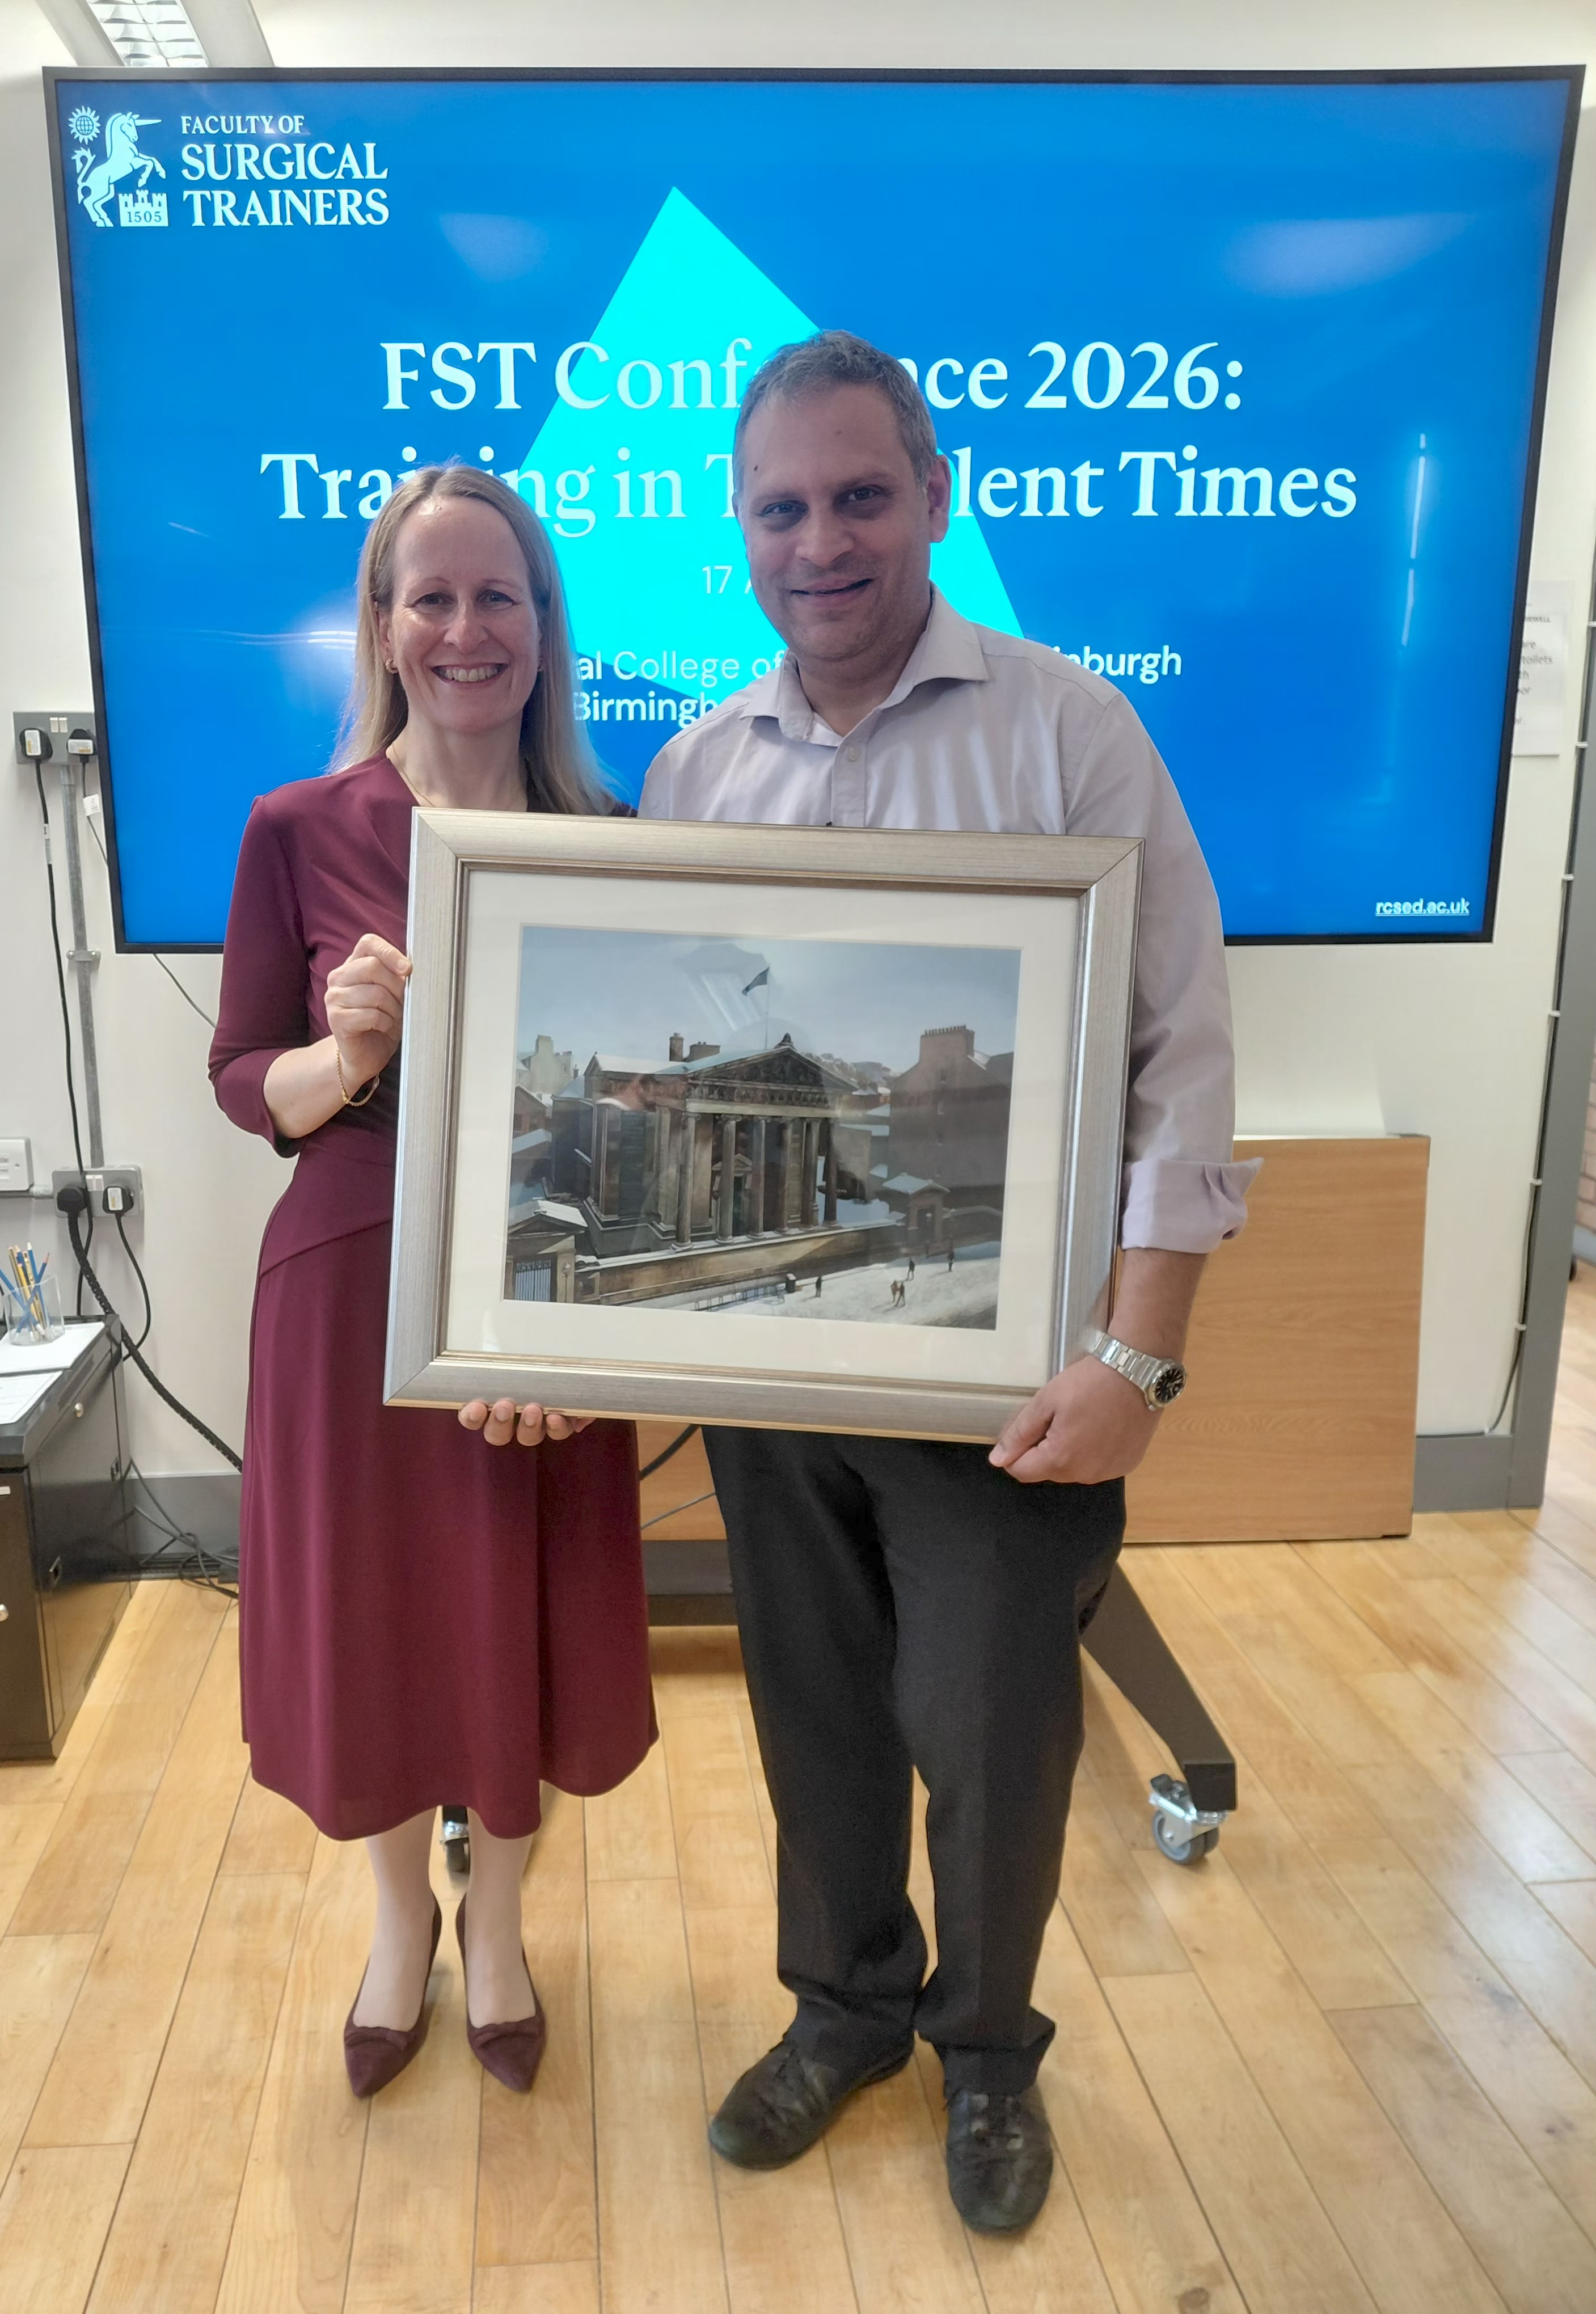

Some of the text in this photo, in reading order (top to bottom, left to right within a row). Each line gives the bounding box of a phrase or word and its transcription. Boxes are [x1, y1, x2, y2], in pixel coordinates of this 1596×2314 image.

[181, 115, 305, 134] FACULTY OF
[181, 142, 389, 181] SURGICAL
[127, 210, 162, 223] 1505
[183, 188, 389, 227] TRAINERS
[379, 341, 537, 410] FST
[1024, 341, 1243, 410] 2026:
[260, 445, 597, 538] Trang
[613, 446, 687, 518] in
[1118, 445, 1357, 518] Times
[702, 565, 733, 594] 17
[613, 650, 740, 688] College
[1375, 897, 1470, 915] rcsed.ac.uk
